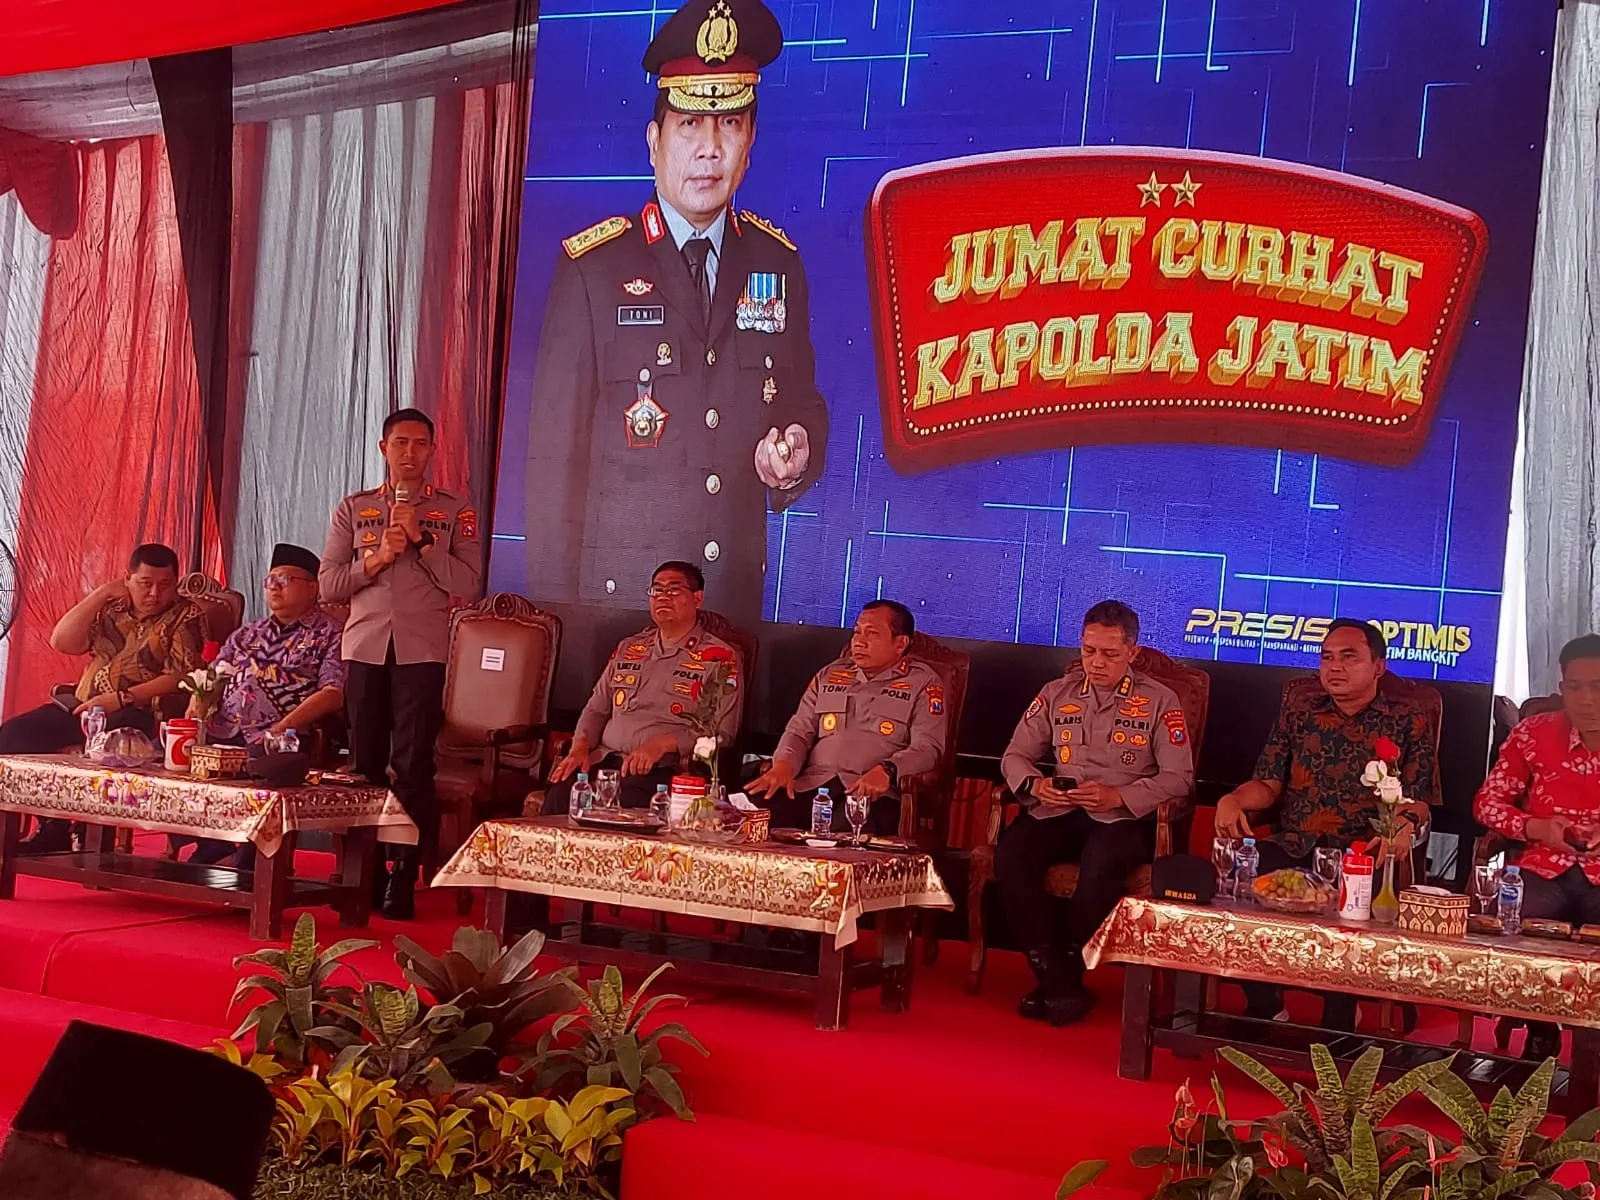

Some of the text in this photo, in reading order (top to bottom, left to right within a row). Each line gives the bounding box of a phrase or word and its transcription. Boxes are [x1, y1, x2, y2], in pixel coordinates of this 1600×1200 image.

[933, 215, 1425, 319] JUMAT CURHAT
[630, 309, 653, 320] TONI
[912, 310, 1428, 411] KAPOLDA JATIM
[357, 517, 385, 529] BAYU
[419, 519, 451, 533] POLRI
[1185, 607, 1332, 643] PRESIS
[1407, 648, 1460, 667] BANGKIT
[672, 669, 704, 681] POLRI
[881, 687, 912, 701] POLRI
[1114, 718, 1150, 730] POLRI
